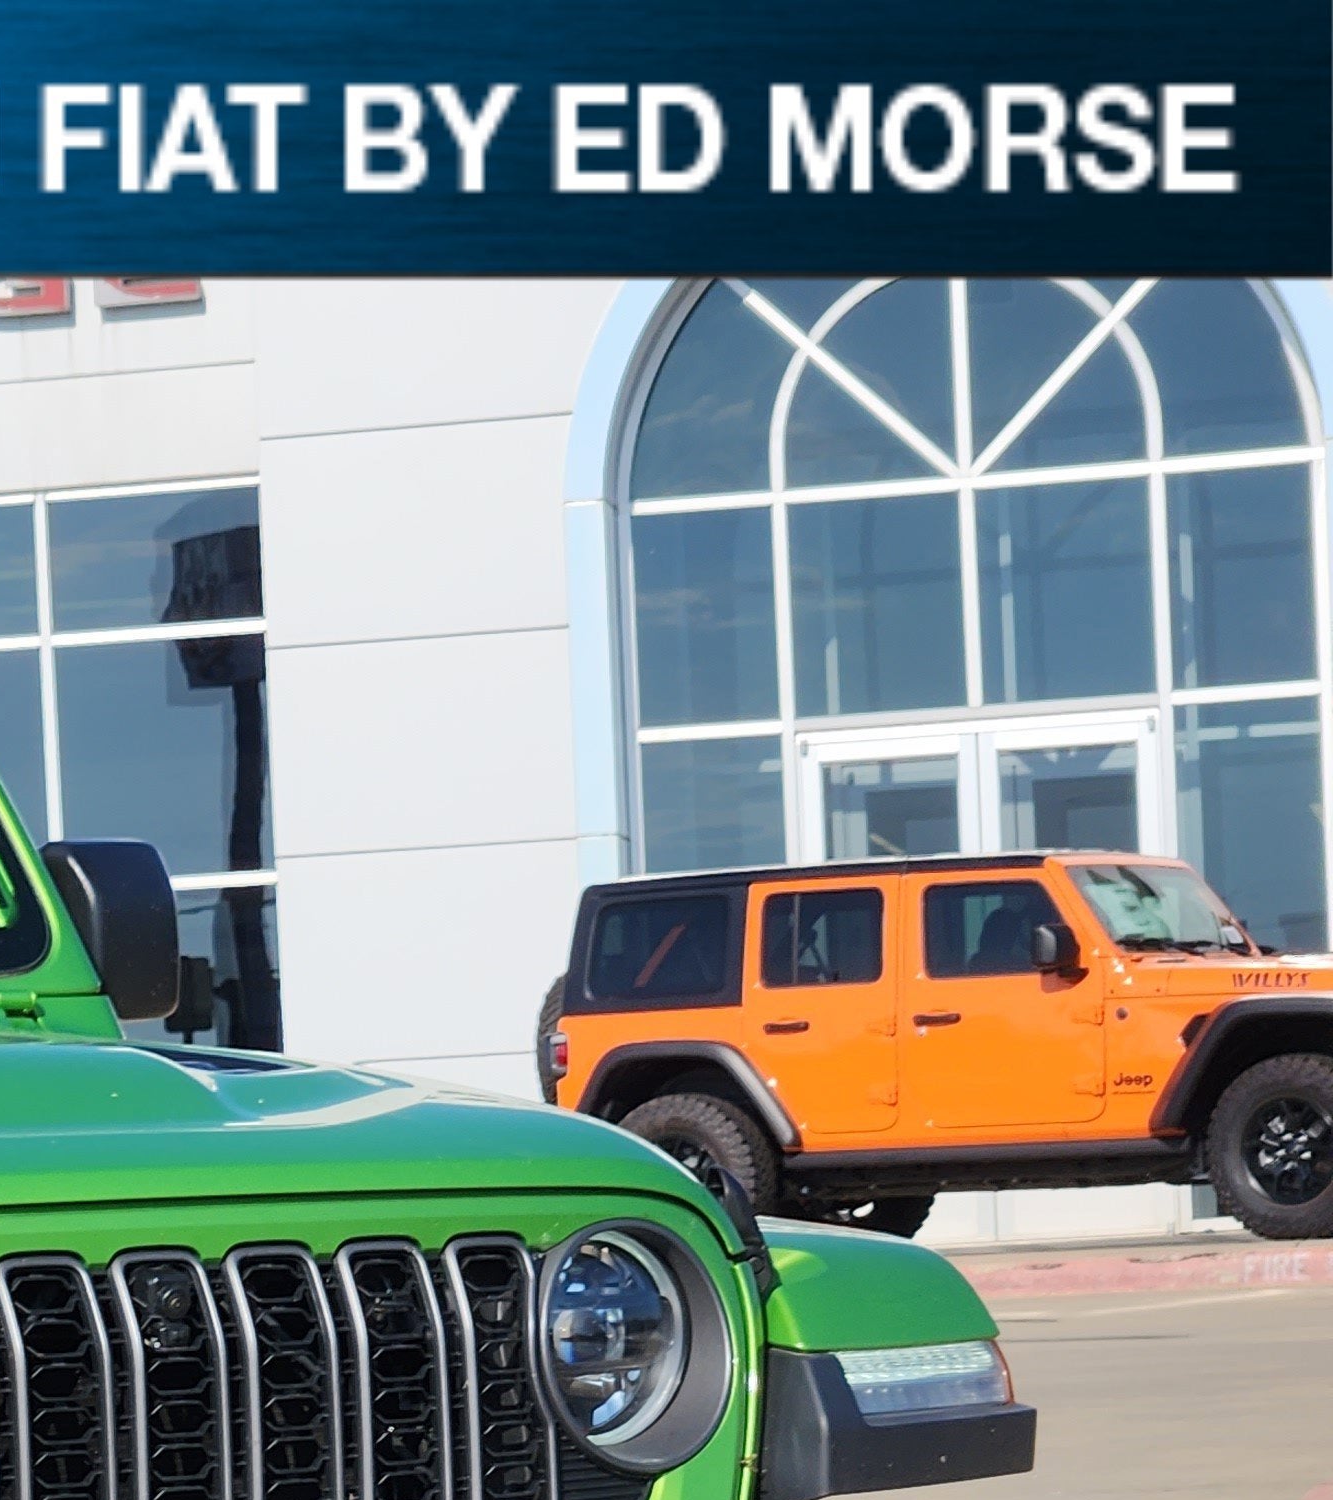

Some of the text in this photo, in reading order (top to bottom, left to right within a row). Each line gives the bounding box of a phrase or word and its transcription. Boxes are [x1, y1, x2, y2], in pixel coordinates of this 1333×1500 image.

[1232, 972, 1312, 988] WILLYS
[1113, 1073, 1154, 1088] Jeep
[1242, 1250, 1312, 1284] FIRE
